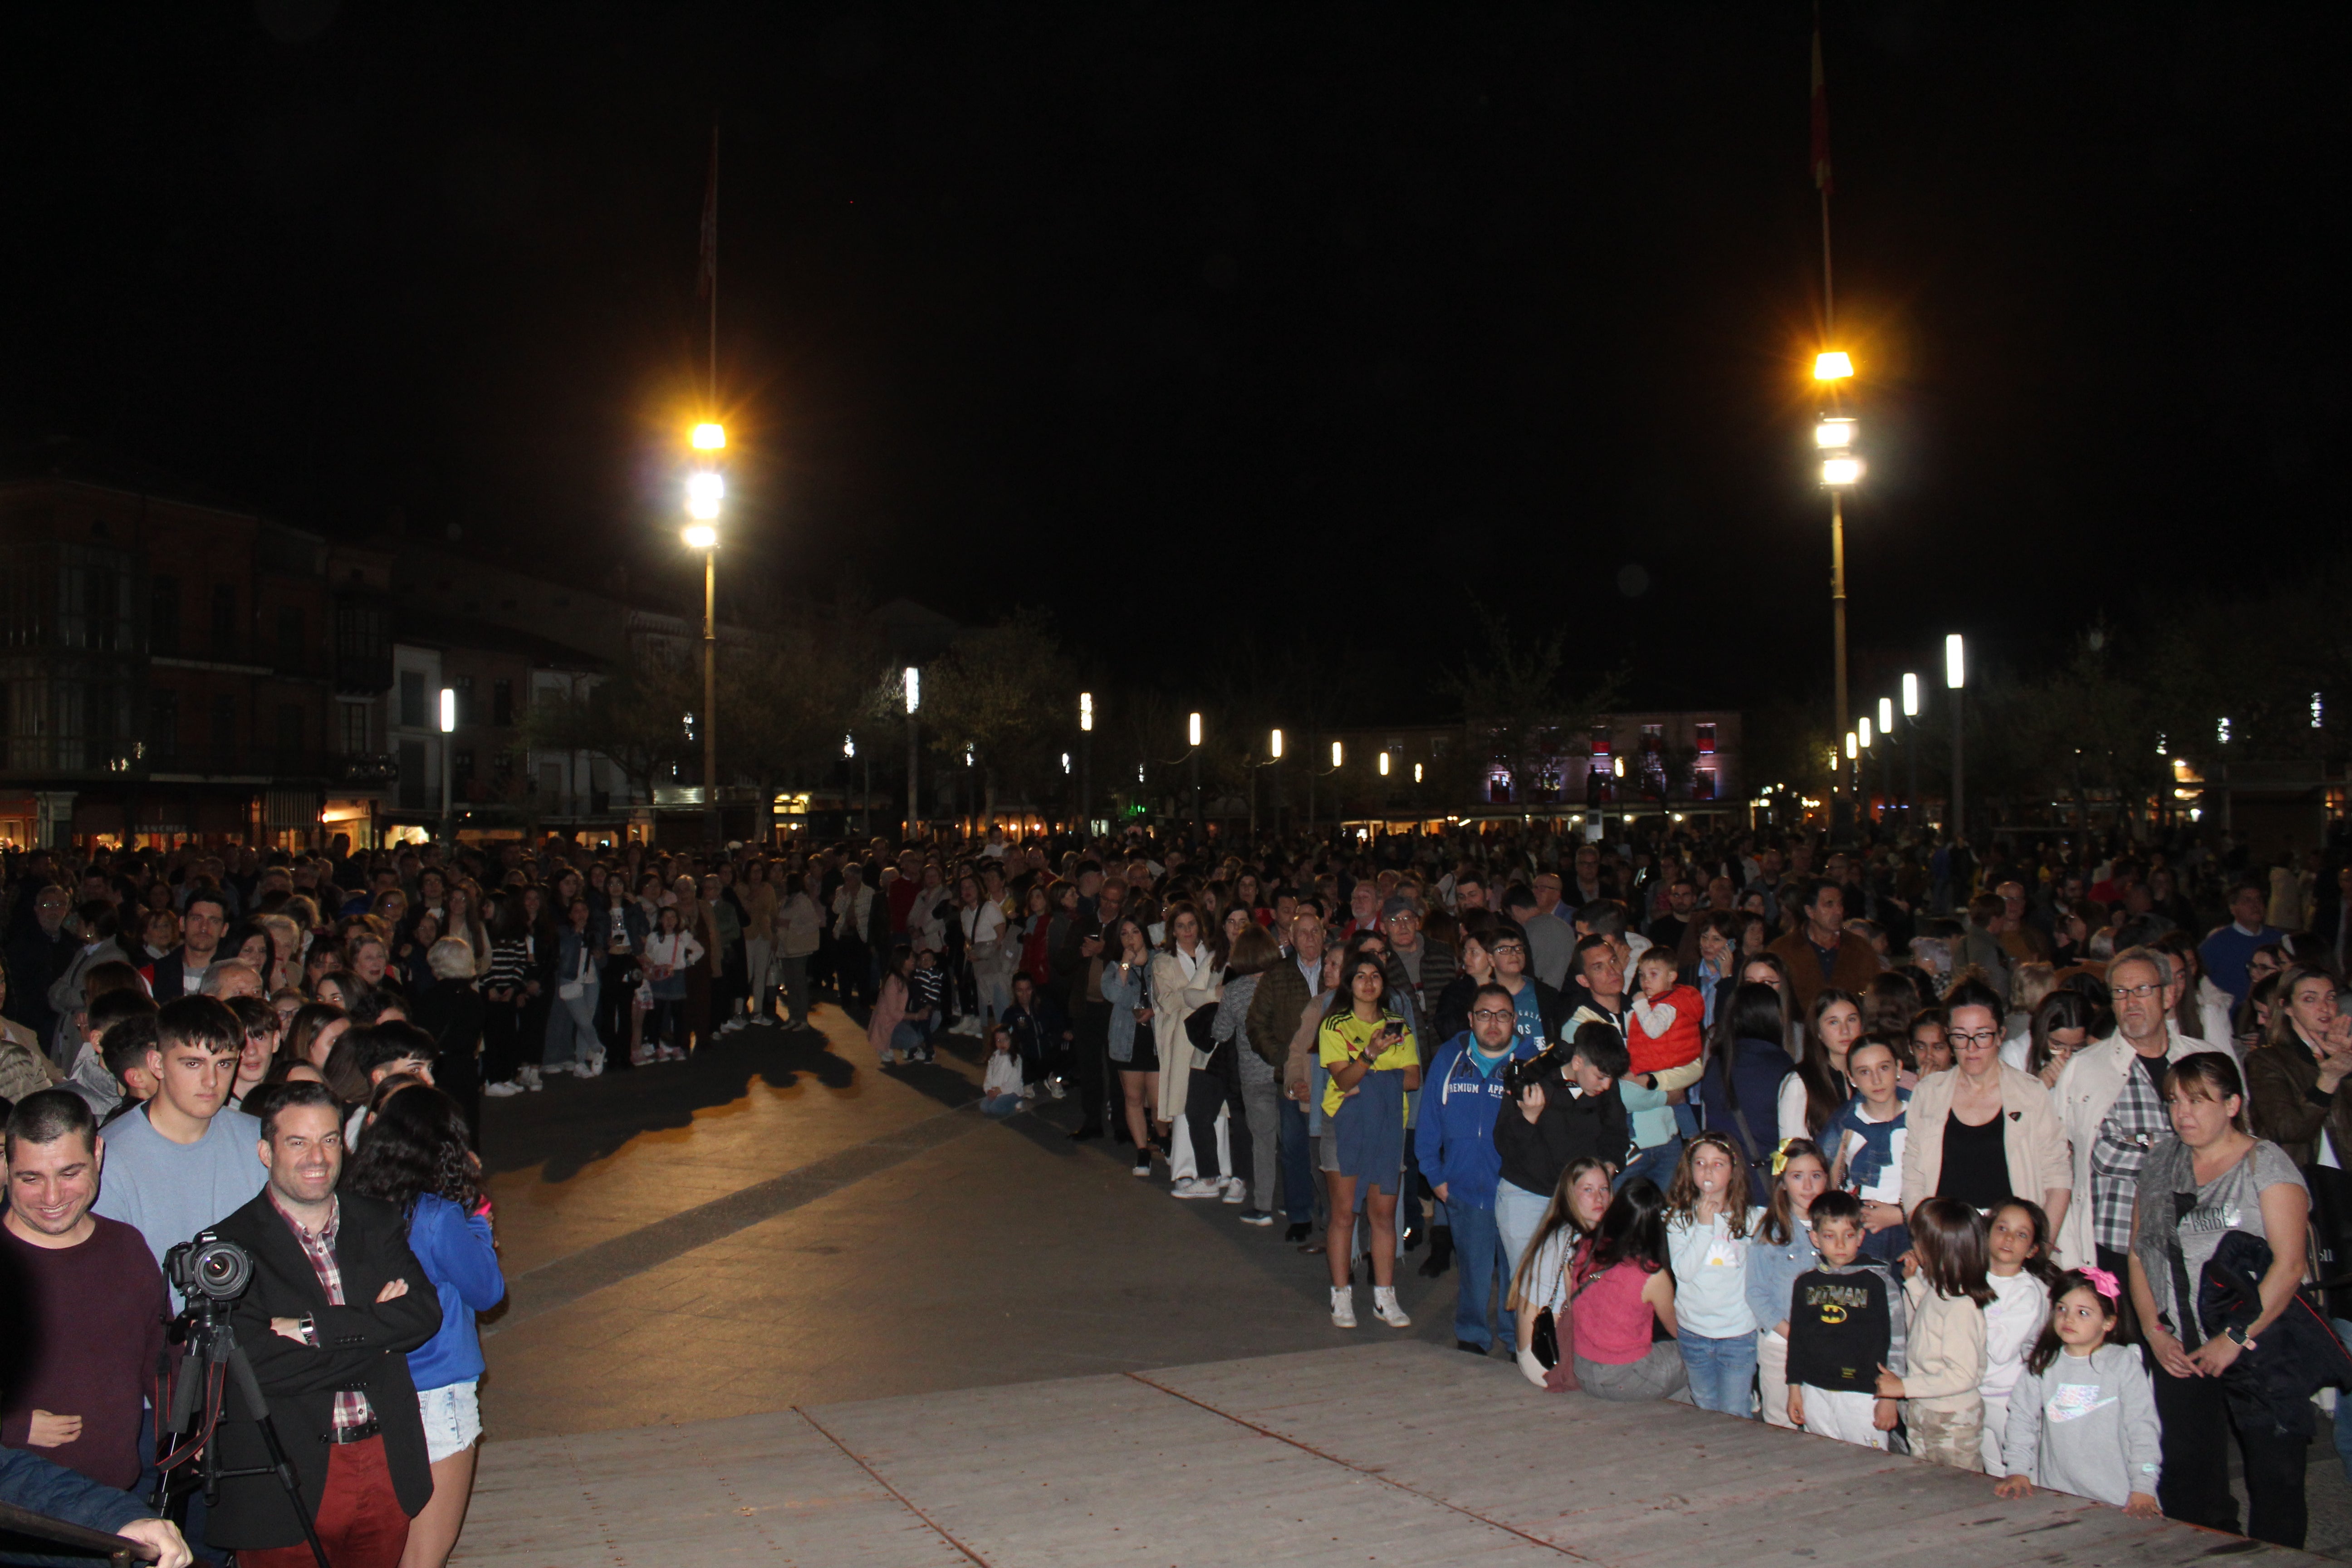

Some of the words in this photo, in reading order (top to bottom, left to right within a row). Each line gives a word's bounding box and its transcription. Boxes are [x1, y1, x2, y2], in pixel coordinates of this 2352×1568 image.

[1448, 1083, 1479, 1093] REMIUM
[1488, 1084, 1504, 1095] APP
[1807, 1285, 1868, 1308] BATMAN
